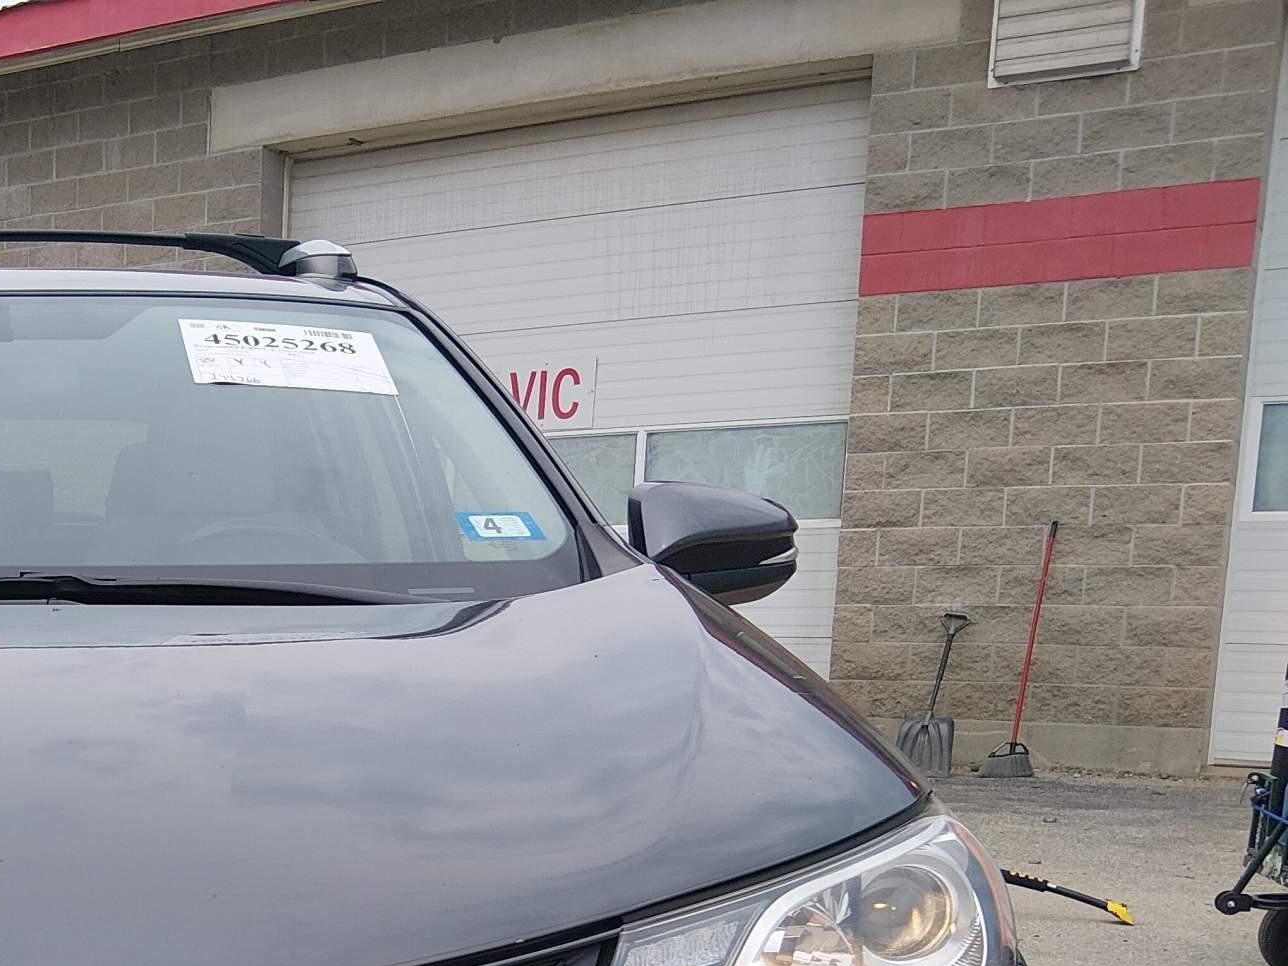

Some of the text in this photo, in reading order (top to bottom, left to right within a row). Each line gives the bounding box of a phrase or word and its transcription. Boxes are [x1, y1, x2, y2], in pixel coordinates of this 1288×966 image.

[204, 333, 357, 355] 45025268
[509, 367, 581, 420] VIC
[483, 517, 503, 534] 4
